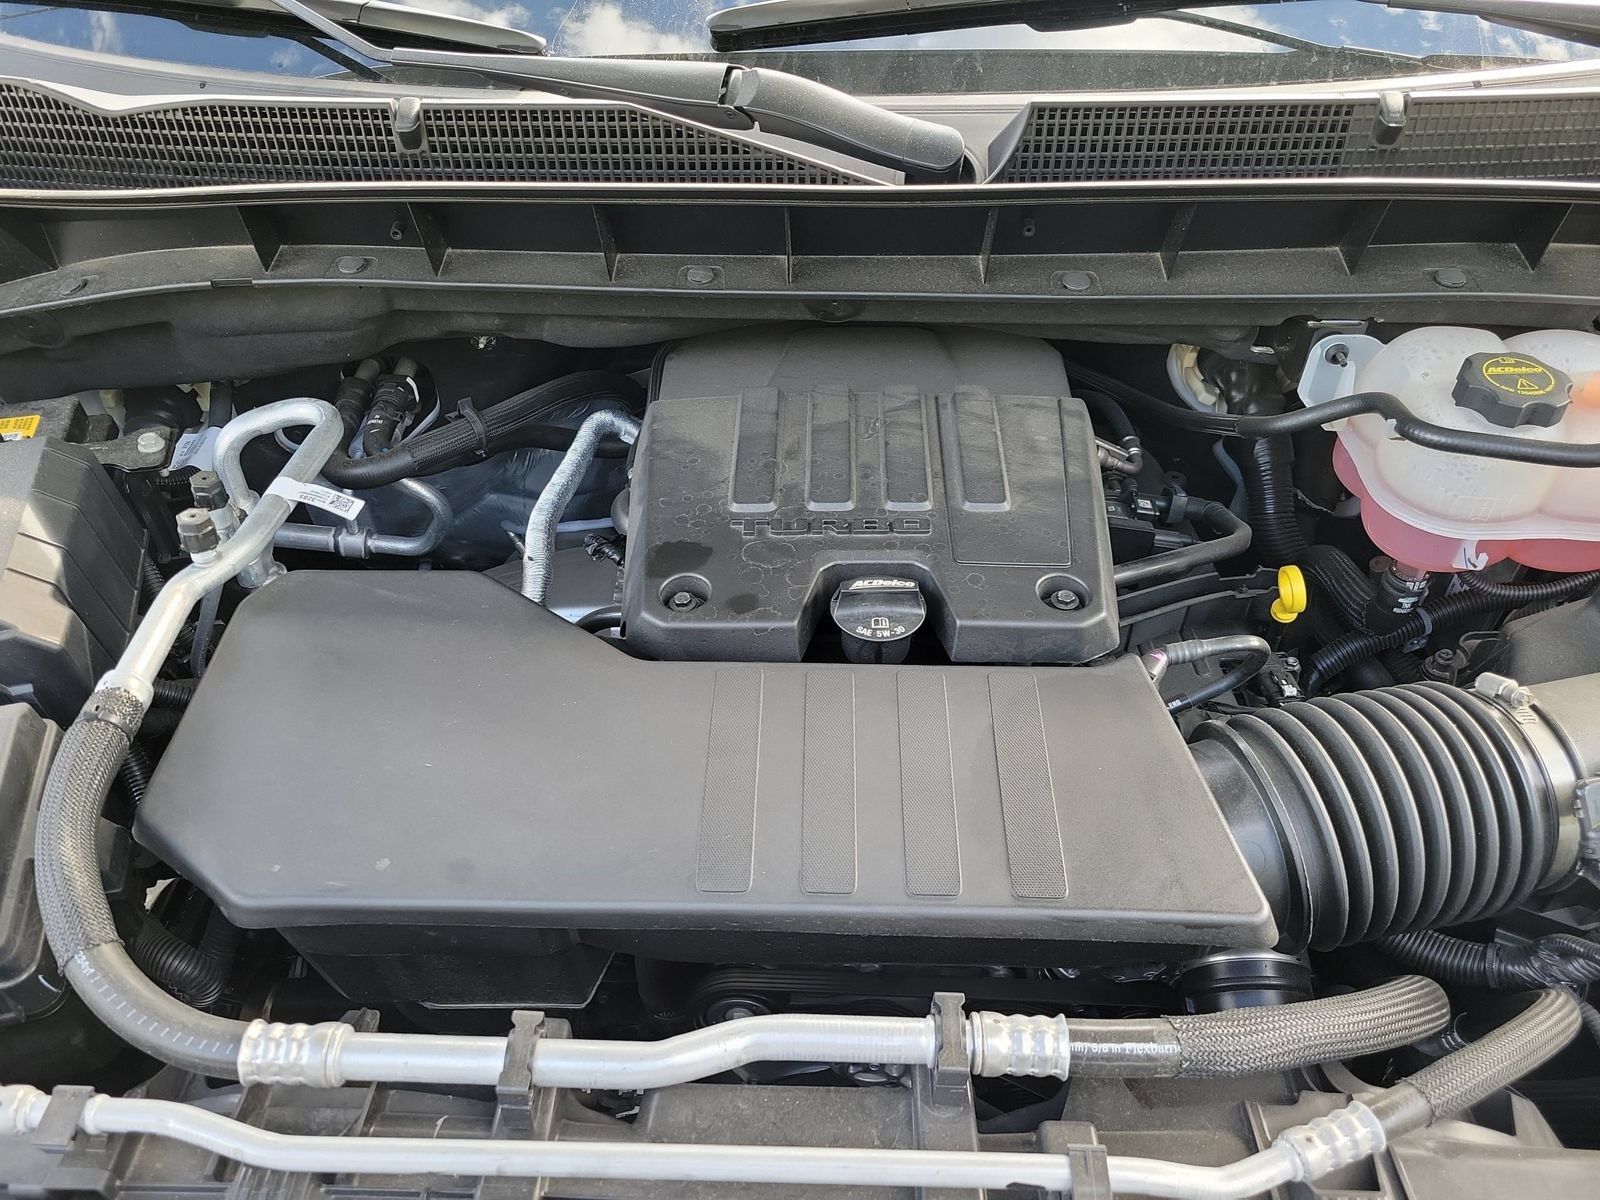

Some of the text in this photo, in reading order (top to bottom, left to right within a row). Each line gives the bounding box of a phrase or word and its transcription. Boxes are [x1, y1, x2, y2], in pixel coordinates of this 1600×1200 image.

[1486, 366, 1543, 375] ACDelco
[731, 518, 932, 538] TURBO
[849, 579, 916, 590] ACDelco
[856, 625, 906, 638] SAE 5W-30
